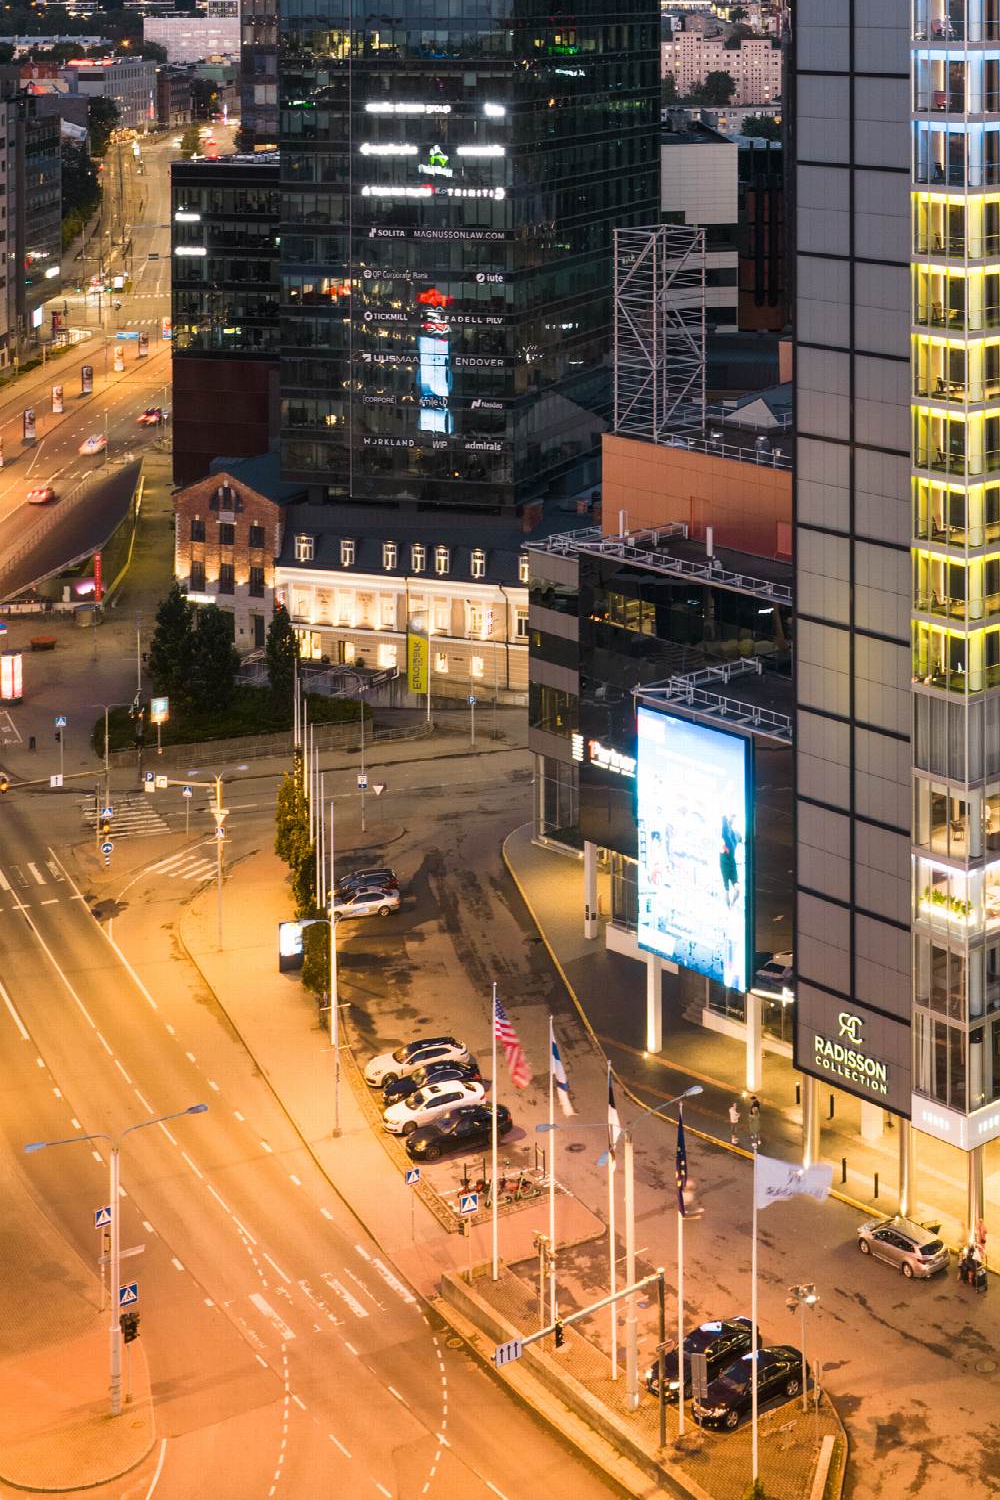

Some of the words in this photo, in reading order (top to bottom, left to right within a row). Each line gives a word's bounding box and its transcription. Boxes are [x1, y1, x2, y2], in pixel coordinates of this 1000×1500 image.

[426, 104, 451, 114] group
[377, 229, 405, 237] SOLITA
[414, 230, 505, 239] MAGNUSSONLAW.COM
[383, 271, 411, 280] Corporate
[487, 273, 504, 283] iute
[373, 313, 408, 321] TICKMILL
[486, 317, 503, 325] PILV
[455, 357, 505, 367] ENDOVER
[465, 441, 502, 451] admirals
[815, 1035, 887, 1082] RADISSON
[815, 1055, 887, 1095] COLLECTION
